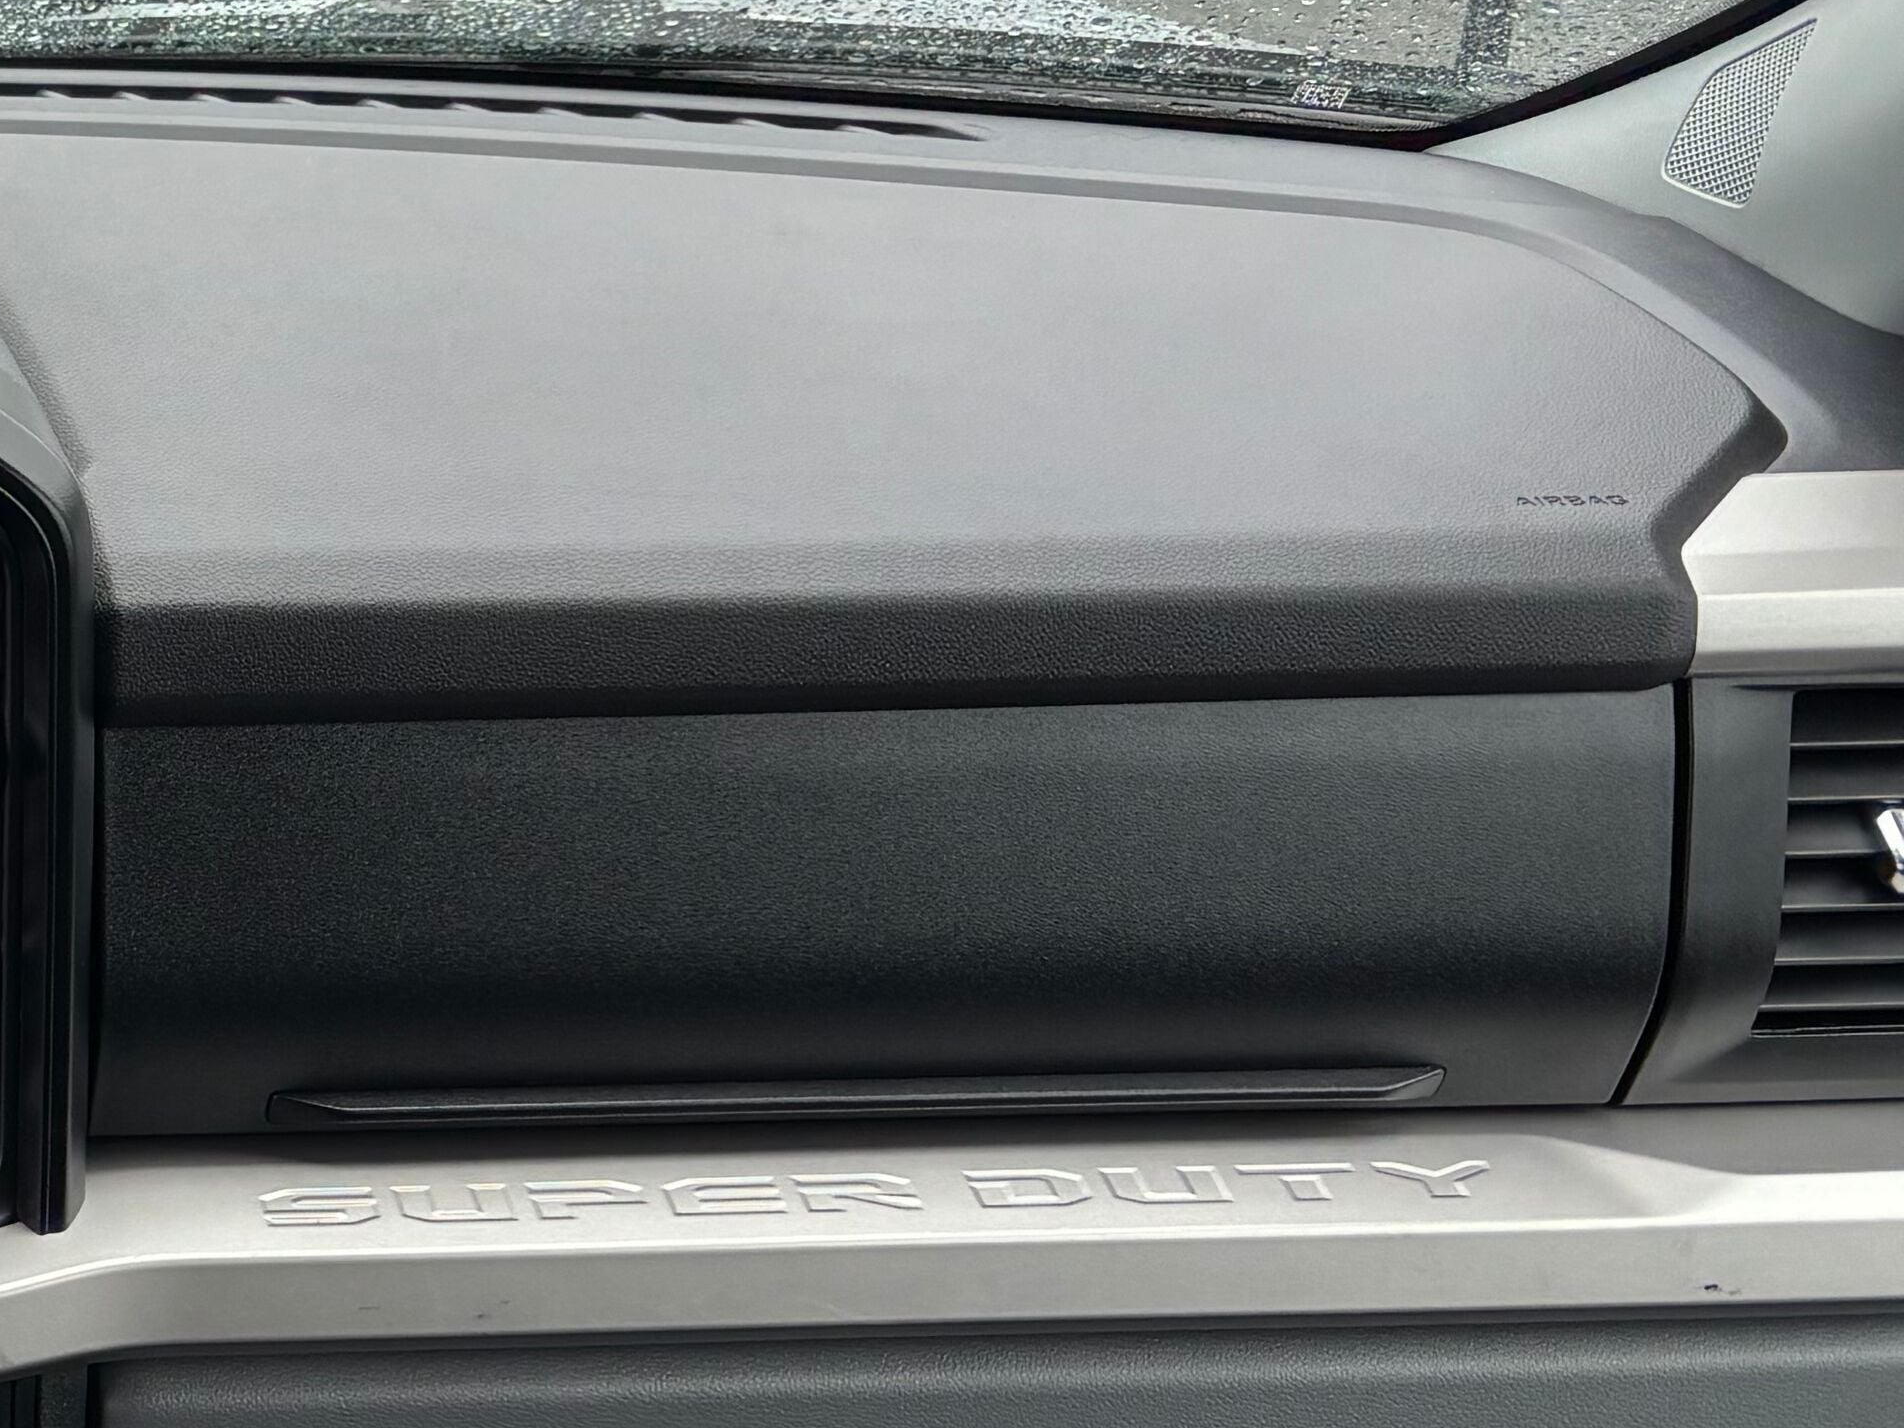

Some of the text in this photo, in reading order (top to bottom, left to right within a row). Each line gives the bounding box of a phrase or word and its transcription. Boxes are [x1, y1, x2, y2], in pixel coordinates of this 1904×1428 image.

[1517, 495, 1630, 506] AIRBAG
[258, 1160, 1491, 1227] SUPER DUTY
